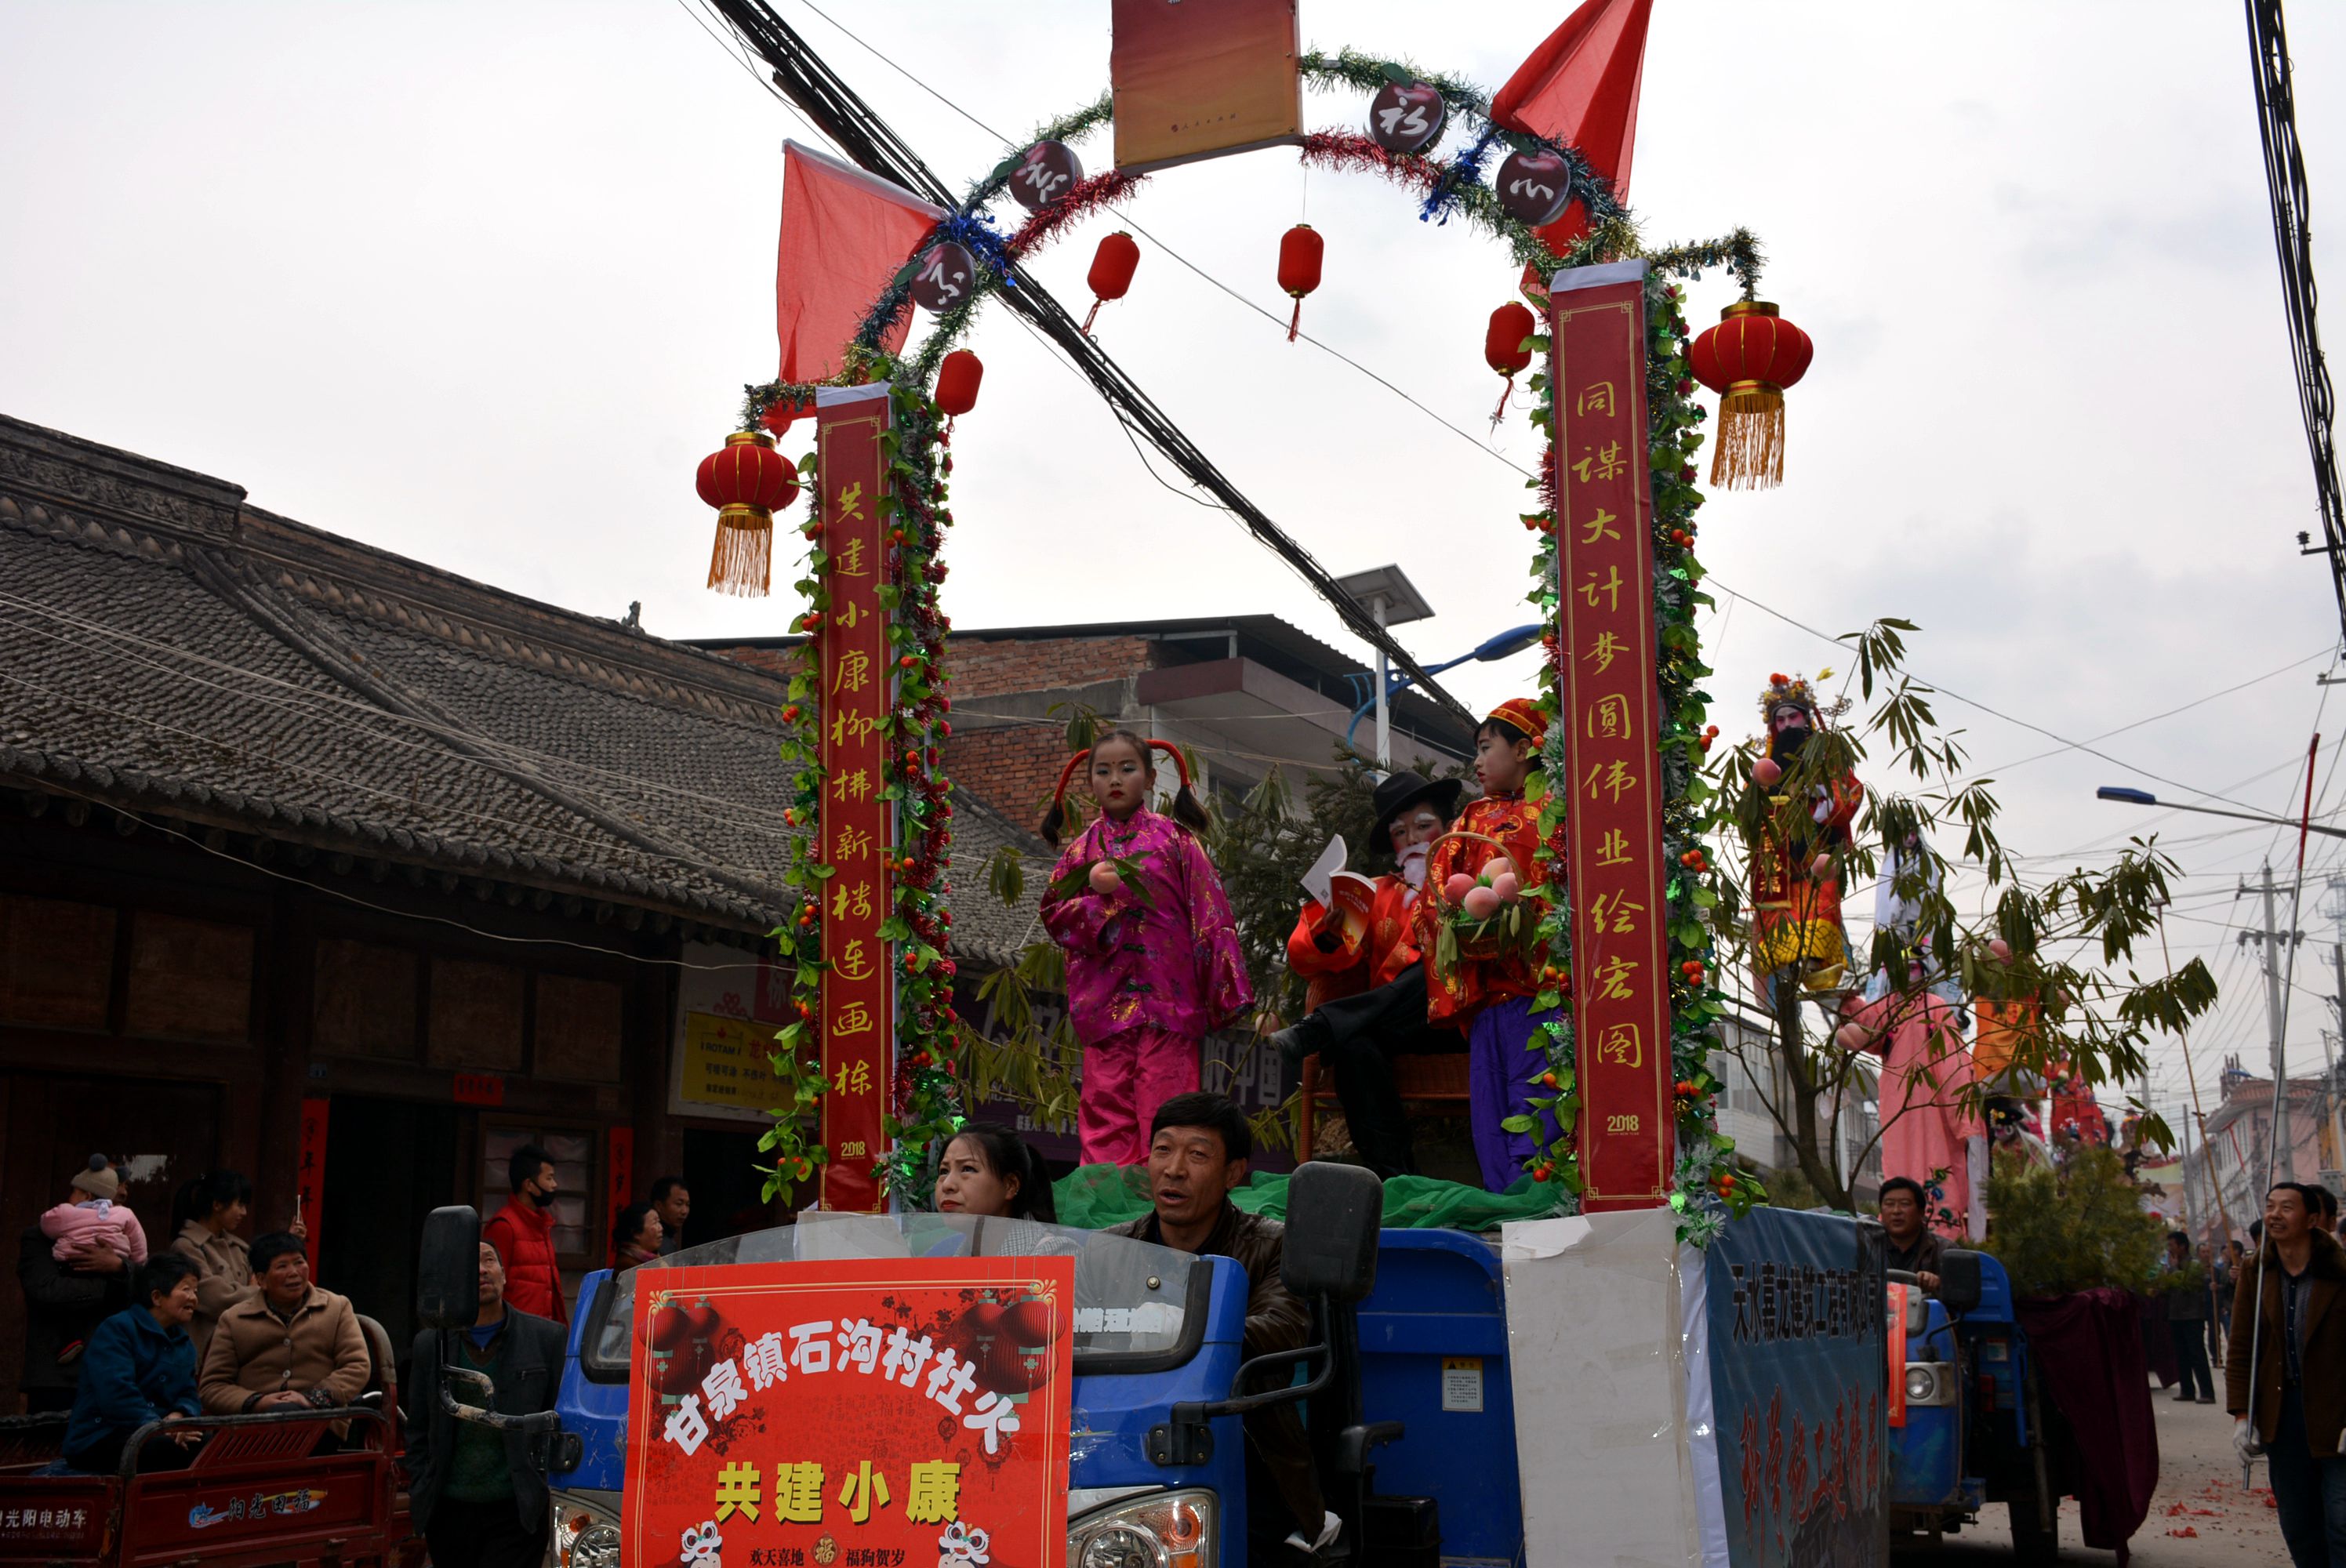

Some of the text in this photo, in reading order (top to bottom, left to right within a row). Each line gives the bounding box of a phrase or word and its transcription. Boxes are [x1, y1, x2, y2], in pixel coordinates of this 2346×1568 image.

[1607, 1114, 1640, 1132] 2018
[841, 1140, 866, 1157] 2018
[1730, 1259, 1879, 1346] 天水嘉龙建筑工程有限公司
[663, 1317, 1020, 1457] 甘泉镇石沟村社火
[714, 1459, 961, 1525] 共建小康
[0, 1508, 88, 1529] 光阳电动车
[750, 1537, 905, 1567] 欢天喜地 福 福狗贺岁
